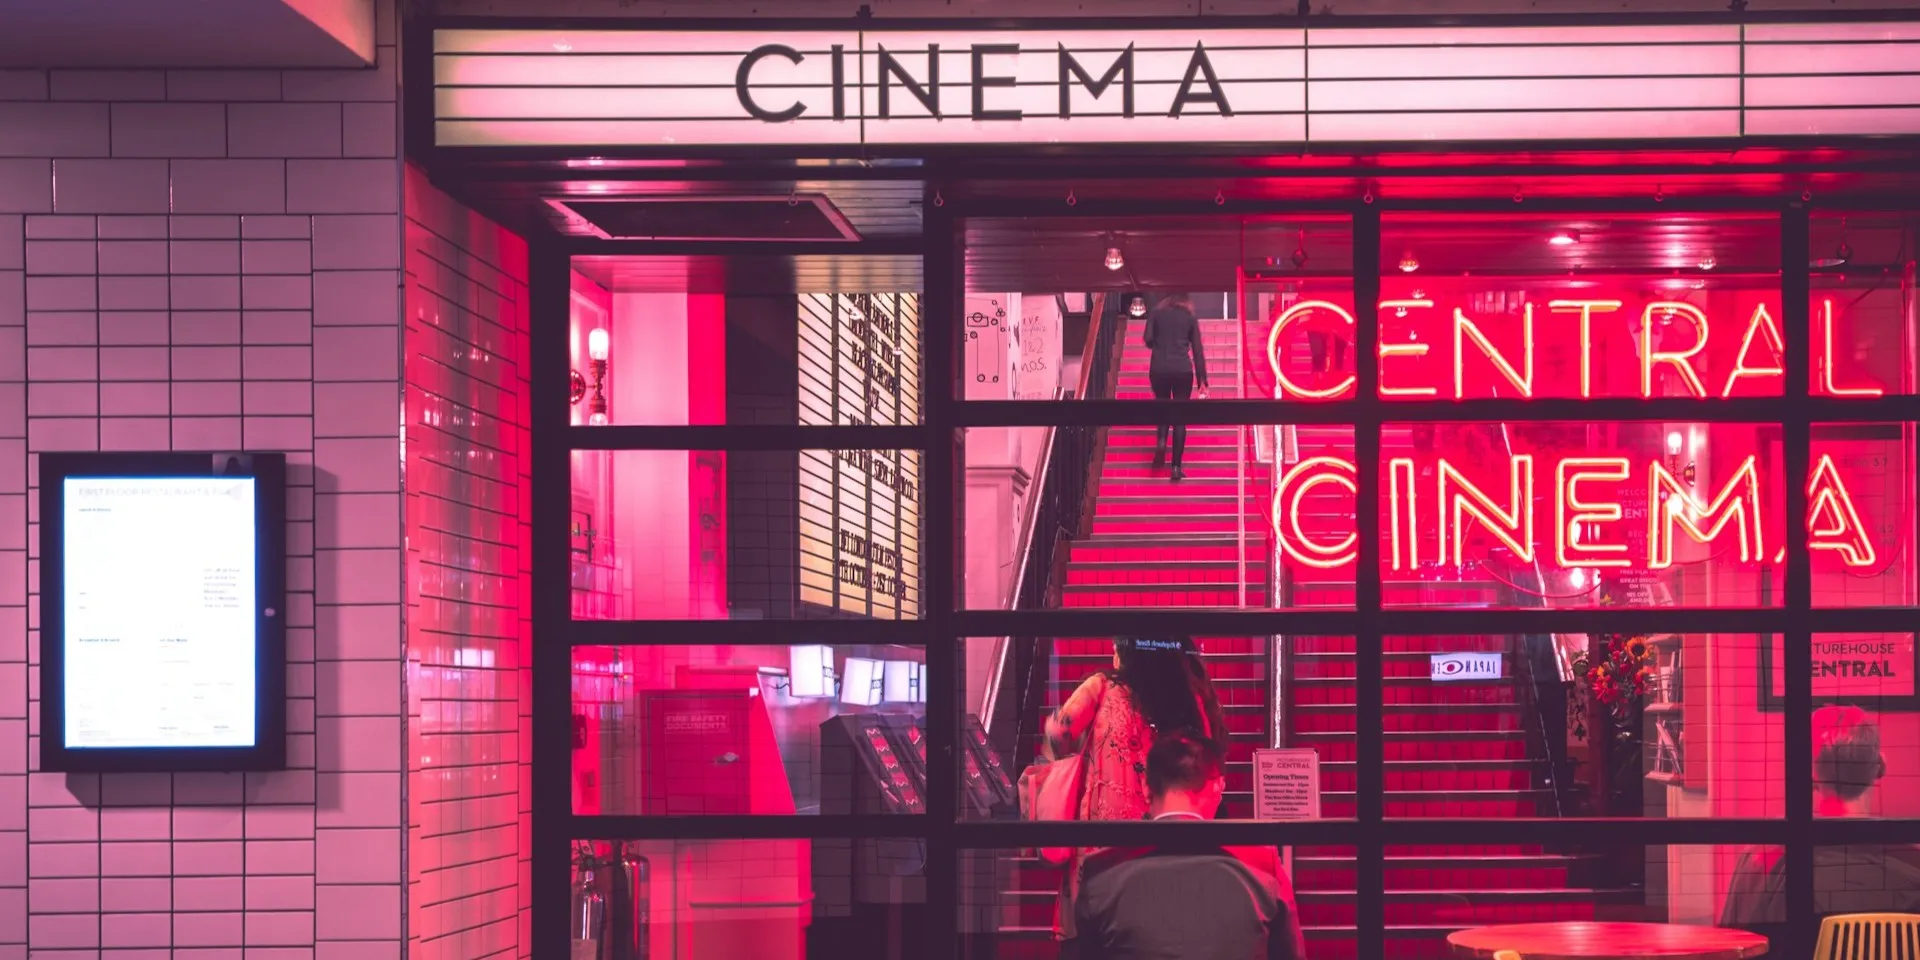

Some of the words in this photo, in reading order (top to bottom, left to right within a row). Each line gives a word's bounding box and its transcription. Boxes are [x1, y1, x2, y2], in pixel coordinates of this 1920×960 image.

[735, 40, 1234, 123] CINEMA
[1267, 299, 1883, 398] CENTRAL
[1271, 454, 1876, 570] CINEMA
[1811, 660, 1896, 678] ENTRAL
[1814, 642, 1896, 655] TUREHOUSE
[666, 722, 727, 730] DOCUMENTS
